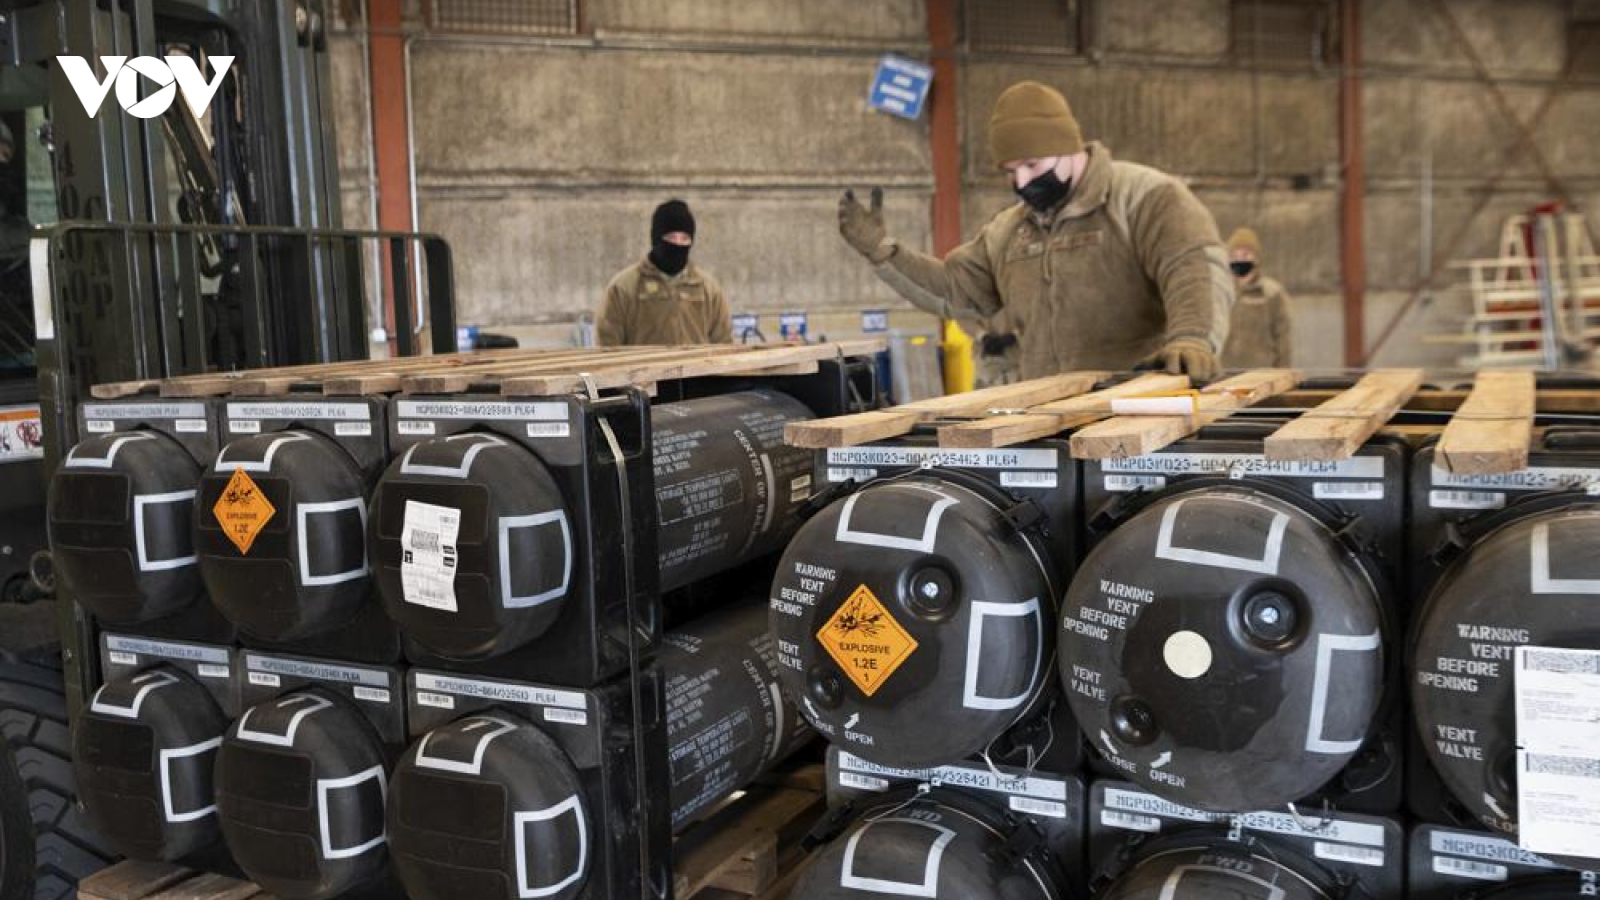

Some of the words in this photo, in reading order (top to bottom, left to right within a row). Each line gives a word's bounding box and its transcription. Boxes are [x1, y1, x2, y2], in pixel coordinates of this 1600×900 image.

[986, 451, 1018, 466] PL64
[1298, 459, 1338, 473] PL64
[795, 562, 836, 581] WARNING
[800, 577, 825, 593] VENT
[1100, 578, 1154, 603] WARNING
[781, 587, 816, 606] BEFORE
[1106, 596, 1140, 617] VENT
[1079, 606, 1127, 630] BEFORE
[1063, 617, 1109, 641] OPENING
[1457, 623, 1530, 643] WARNING
[778, 640, 800, 656] VENT
[839, 641, 891, 656] EXPLOSIVE
[1471, 643, 1513, 660] VENT
[777, 652, 803, 671] VALVE
[853, 658, 878, 670] 1.2E
[1437, 657, 1499, 678] BEFORE
[864, 673, 869, 682] 1
[1073, 663, 1102, 684] VENT
[1418, 671, 1478, 692] OPENING
[1071, 678, 1106, 701] VALVE
[844, 730, 874, 746] OPEN
[1437, 725, 1477, 743] VENT
[1437, 741, 1483, 761] VALVE
[1149, 769, 1186, 788] OPEN
